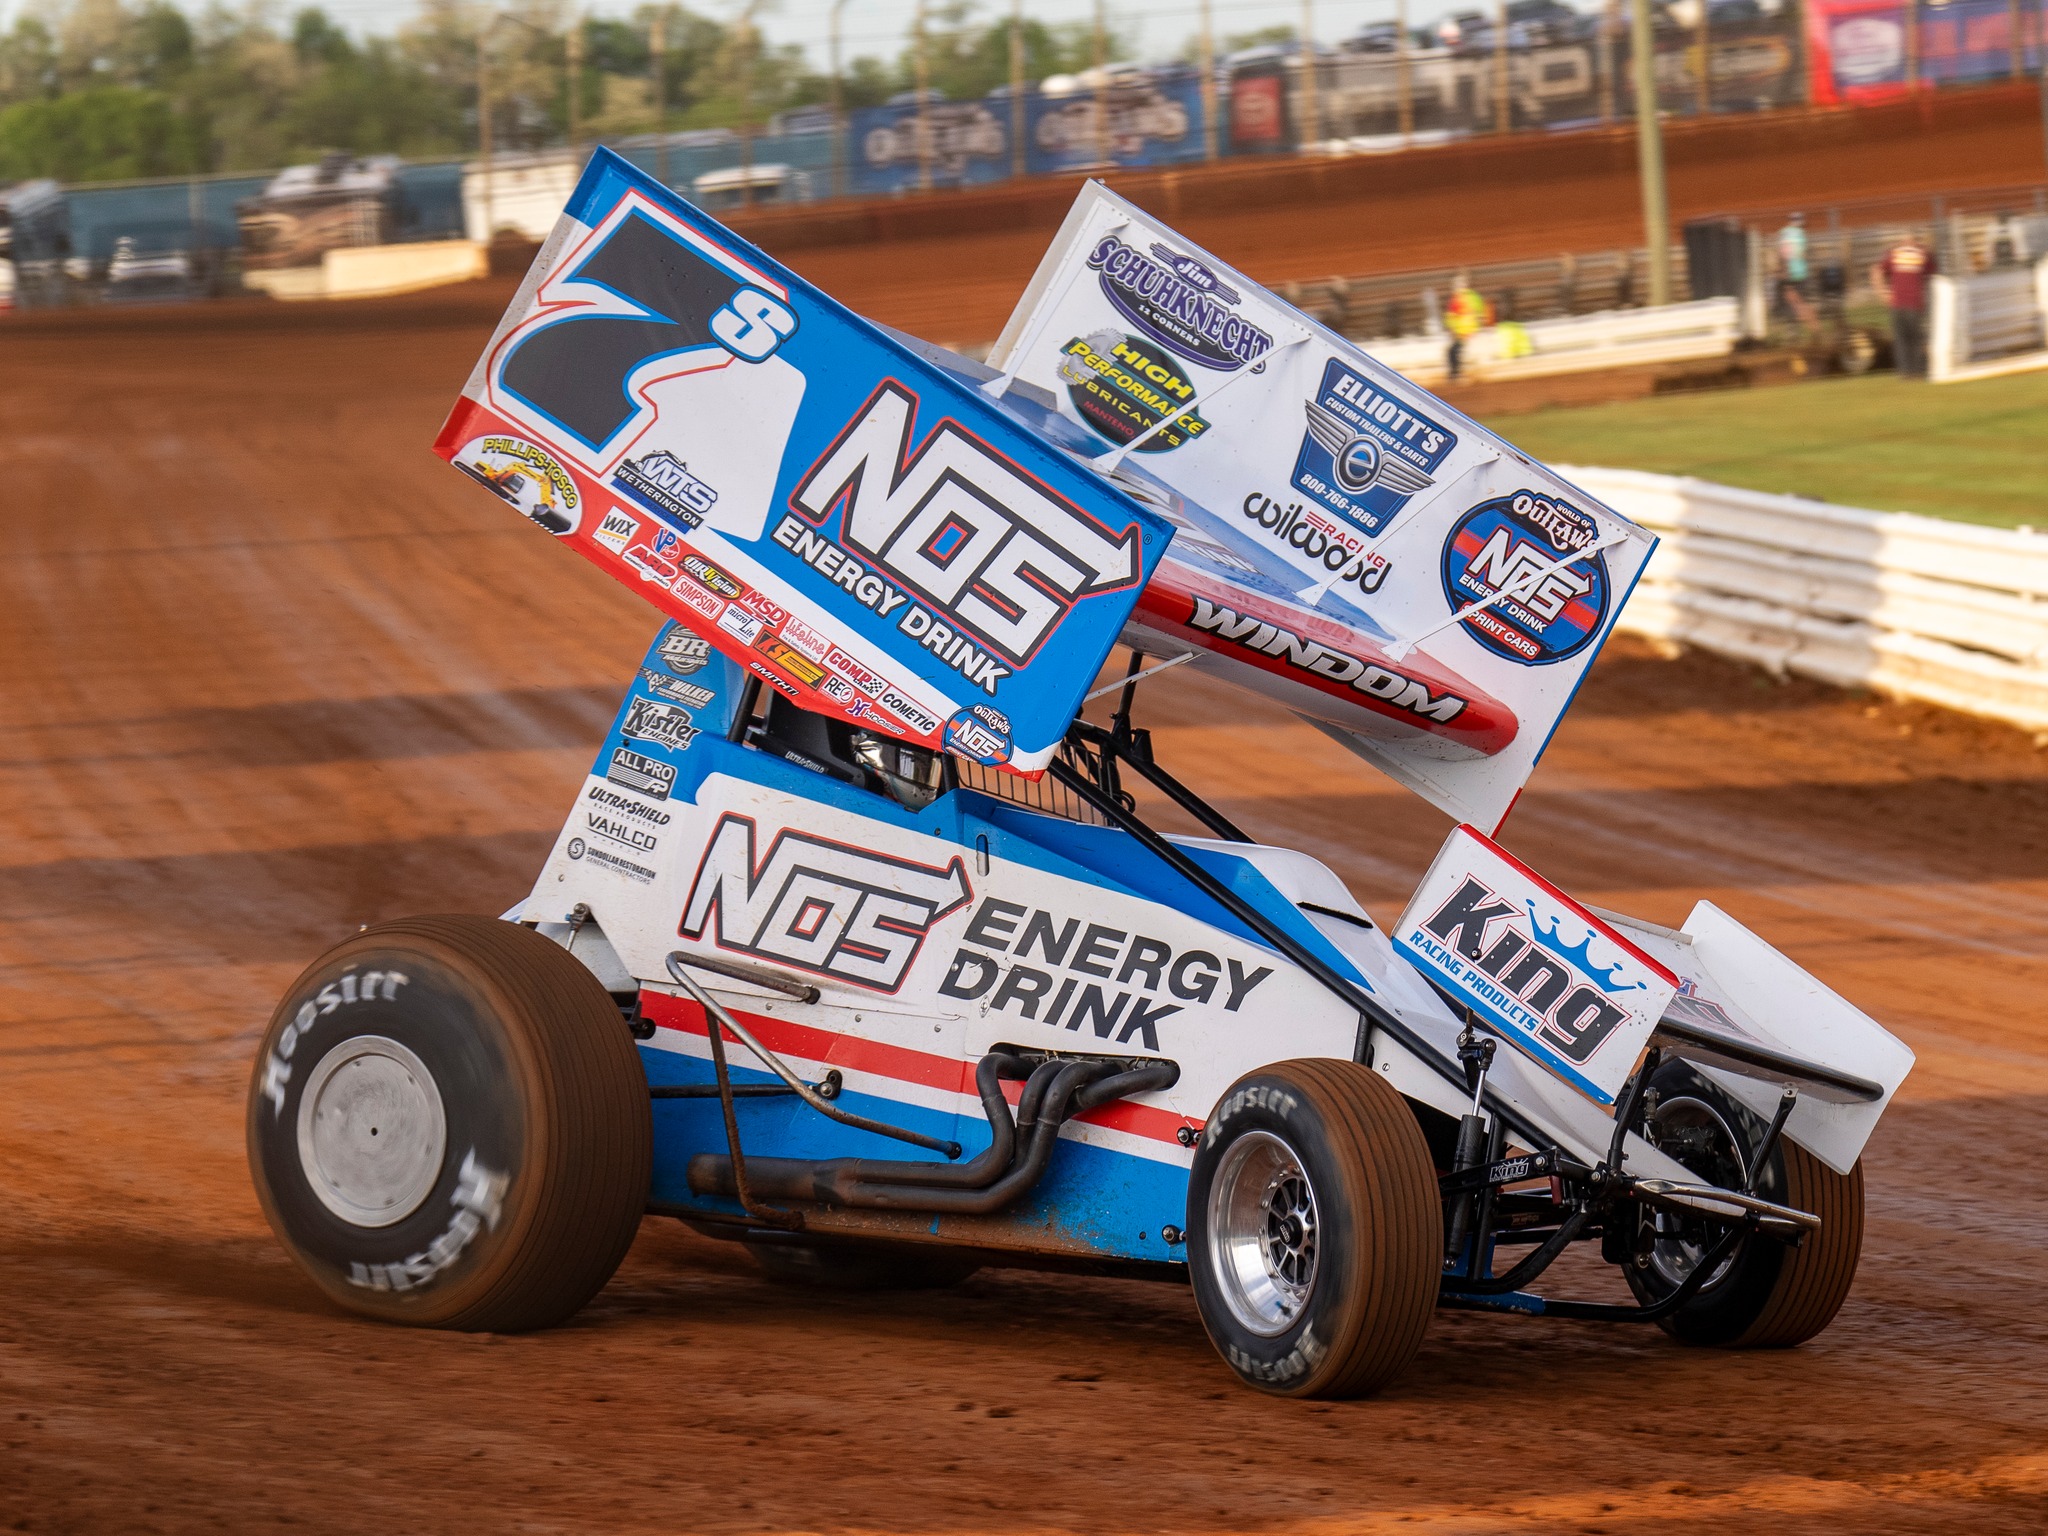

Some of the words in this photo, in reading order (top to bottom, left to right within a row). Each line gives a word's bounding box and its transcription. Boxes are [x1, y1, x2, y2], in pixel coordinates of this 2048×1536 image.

[1176, 260, 1212, 289] Jim
[1088, 236, 1273, 373] SCHUHKNECHT
[1137, 304, 1151, 316] 12
[1151, 311, 1200, 347] CORNERS
[1111, 342, 1193, 399] HIGH
[1325, 396, 1361, 425] CUSTOM
[1358, 416, 1396, 447] TRAILERS
[1393, 440, 1402, 451] &
[1400, 445, 1430, 467] CARTS
[1332, 373, 1445, 454] ELLIOTT'S
[482, 438, 578, 509] PHILLIPS-TOSCO
[640, 457, 718, 513] WTS
[617, 467, 700, 527] WETHERINGTON
[1300, 473, 1379, 528] 800-766-1886
[1556, 503, 1581, 522] WORLD
[1580, 518, 1591, 528] OF
[602, 514, 637, 537] WIX
[789, 377, 1142, 670] NOS
[676, 581, 720, 616] SIMPSON
[743, 591, 786, 622] MSD
[772, 514, 905, 616] ENERGY
[899, 608, 1008, 696] DRINK
[1507, 605, 1548, 634] DRINK
[659, 634, 711, 658] BR
[1188, 596, 1467, 723] WINDOM
[1503, 631, 1538, 657] CARS
[829, 652, 873, 684] COMP
[853, 678, 874, 694] CAMS
[669, 680, 716, 703] WALKER
[624, 701, 701, 742] Kistler
[863, 710, 905, 735] HOOSIER
[882, 693, 936, 731] COMETIC
[641, 729, 690, 750] ENGINES
[953, 718, 1006, 757] NOS
[615, 751, 642, 771] ALL
[642, 760, 673, 781] PRO
[588, 812, 658, 851] VAHLCO
[619, 858, 657, 880] RESTORATION
[679, 812, 974, 994] NOS
[962, 896, 1274, 1012] ENERGY
[1420, 874, 1632, 1065] King
[937, 949, 1184, 1052] DRINK
[1409, 931, 1465, 976] RACING
[1461, 970, 1540, 1032] PRODUCTS
